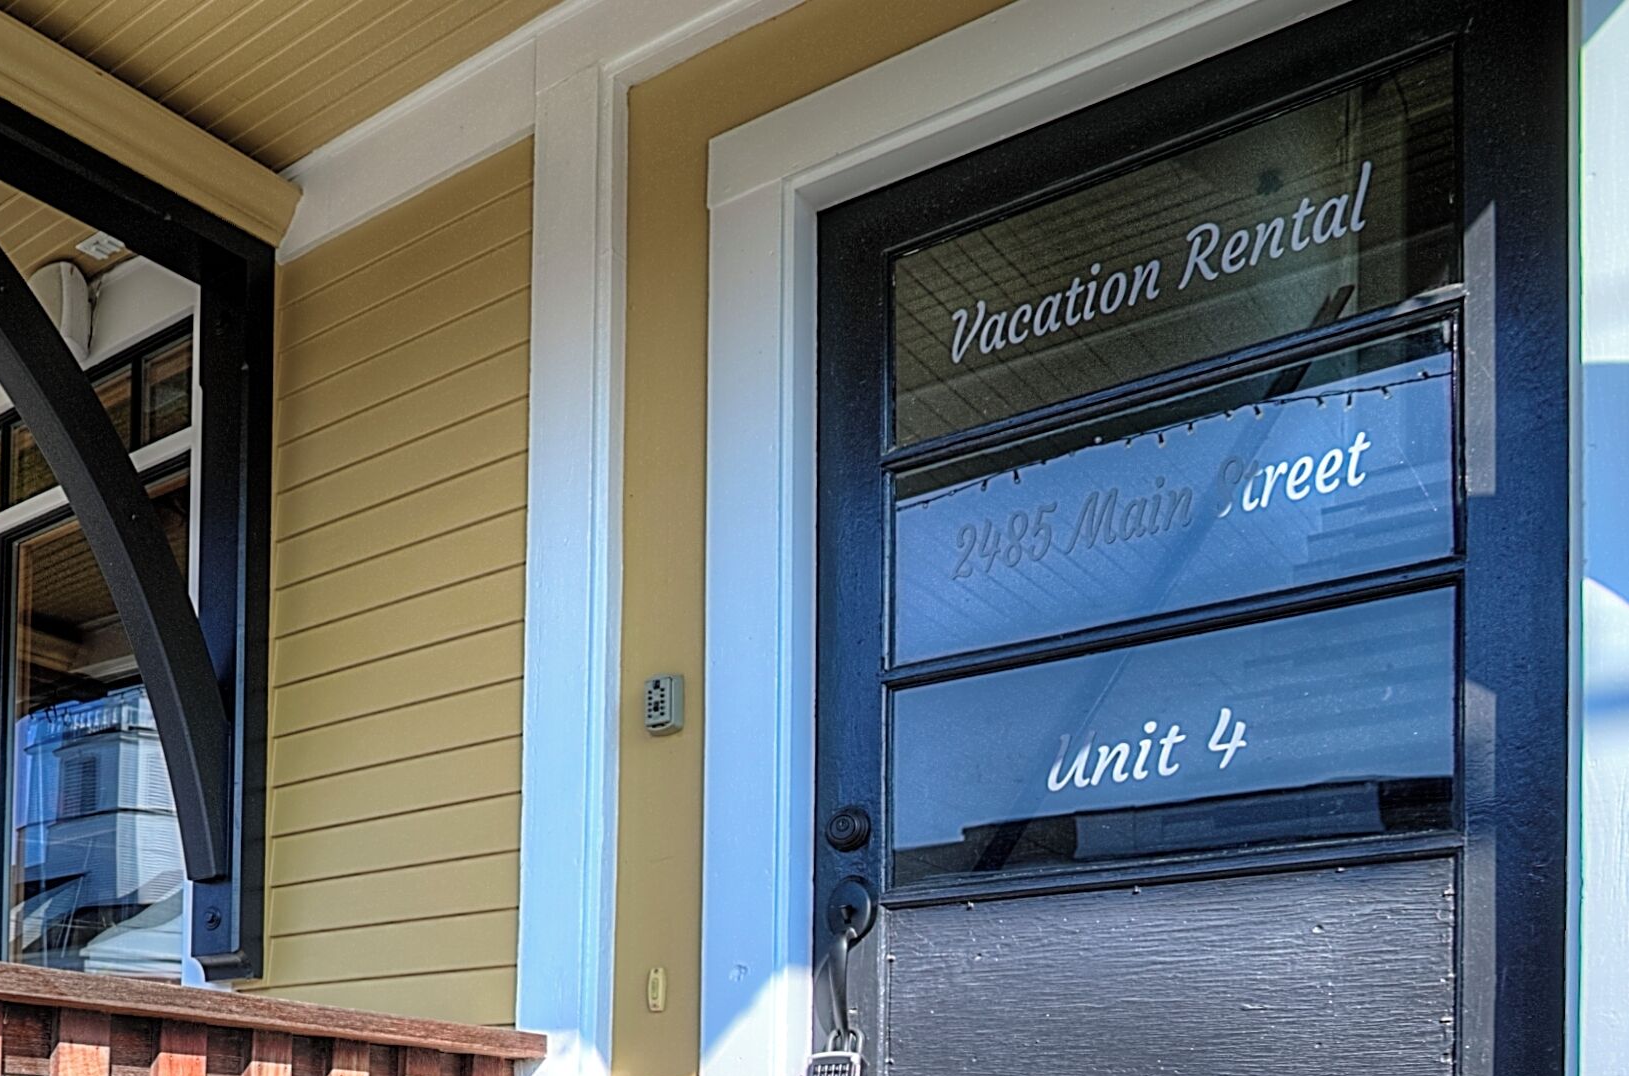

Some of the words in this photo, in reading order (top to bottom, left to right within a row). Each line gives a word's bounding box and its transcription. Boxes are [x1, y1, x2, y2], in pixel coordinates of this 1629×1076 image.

[950, 258, 1161, 365] Vacation
[1177, 160, 1373, 291] Rental
[951, 500, 1059, 581] 2485
[1061, 475, 1194, 554] Main
[1216, 431, 1371, 518] Street
[1046, 720, 1186, 793] Unit
[1207, 706, 1248, 770] 4
